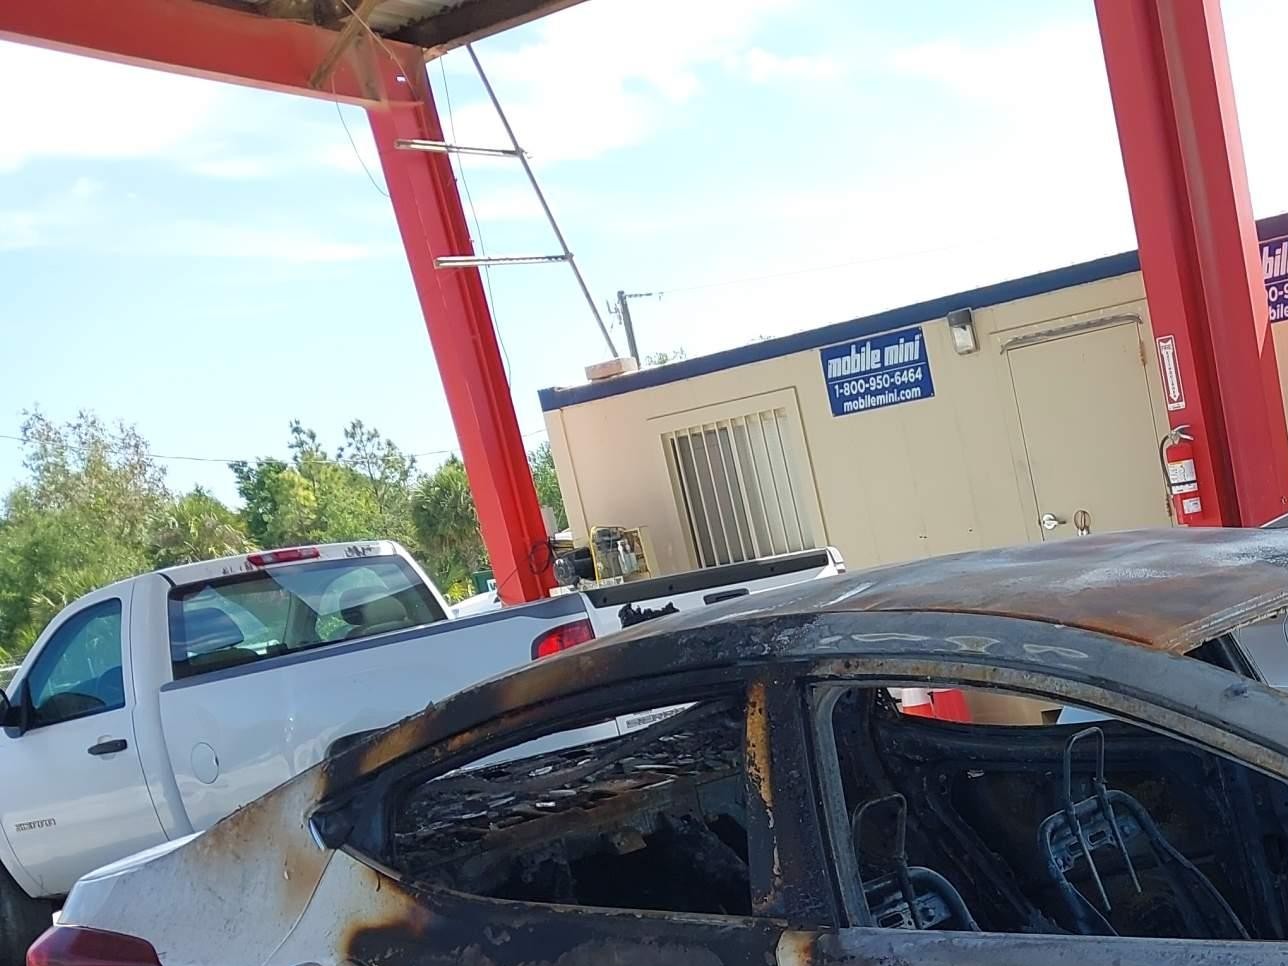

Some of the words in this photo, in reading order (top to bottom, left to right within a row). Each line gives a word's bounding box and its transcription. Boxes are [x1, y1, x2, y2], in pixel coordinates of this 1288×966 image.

[828, 341, 881, 379] mobile
[884, 334, 920, 366] mini
[834, 367, 923, 398] 1-800-950-6464
[843, 386, 921, 413] mobilemini.com
